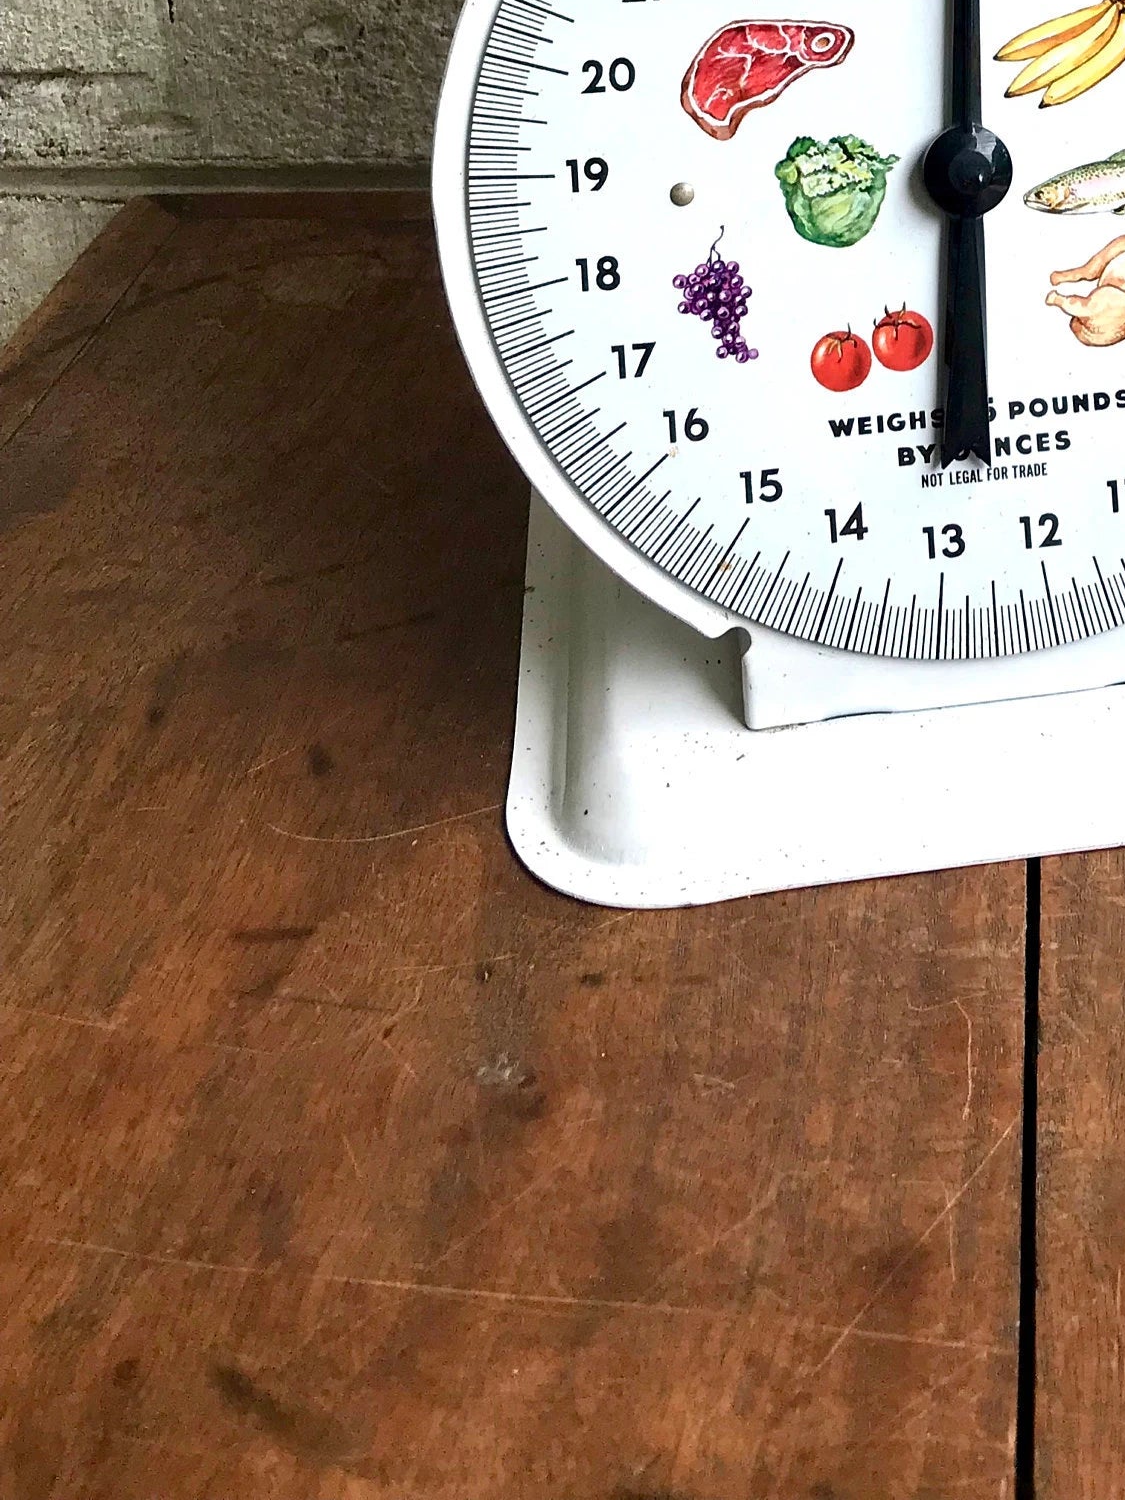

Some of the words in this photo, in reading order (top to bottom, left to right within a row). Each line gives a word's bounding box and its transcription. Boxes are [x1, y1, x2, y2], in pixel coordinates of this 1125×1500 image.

[580, 57, 636, 95] 20
[565, 157, 609, 193] 19
[575, 255, 621, 292] 18
[610, 341, 657, 380] 17
[662, 407, 710, 444] 16
[828, 408, 945, 438] WEIGHS
[898, 444, 937, 467] BY
[953, 431, 1071, 462] NCES
[739, 468, 783, 504] 15
[921, 473, 944, 489] NOT
[949, 469, 984, 486] LEGAL
[987, 465, 1008, 482] FOR
[1012, 462, 1048, 480] TRADE
[824, 501, 869, 544] 14
[1019, 512, 1063, 550] 12
[922, 523, 966, 560] 13
